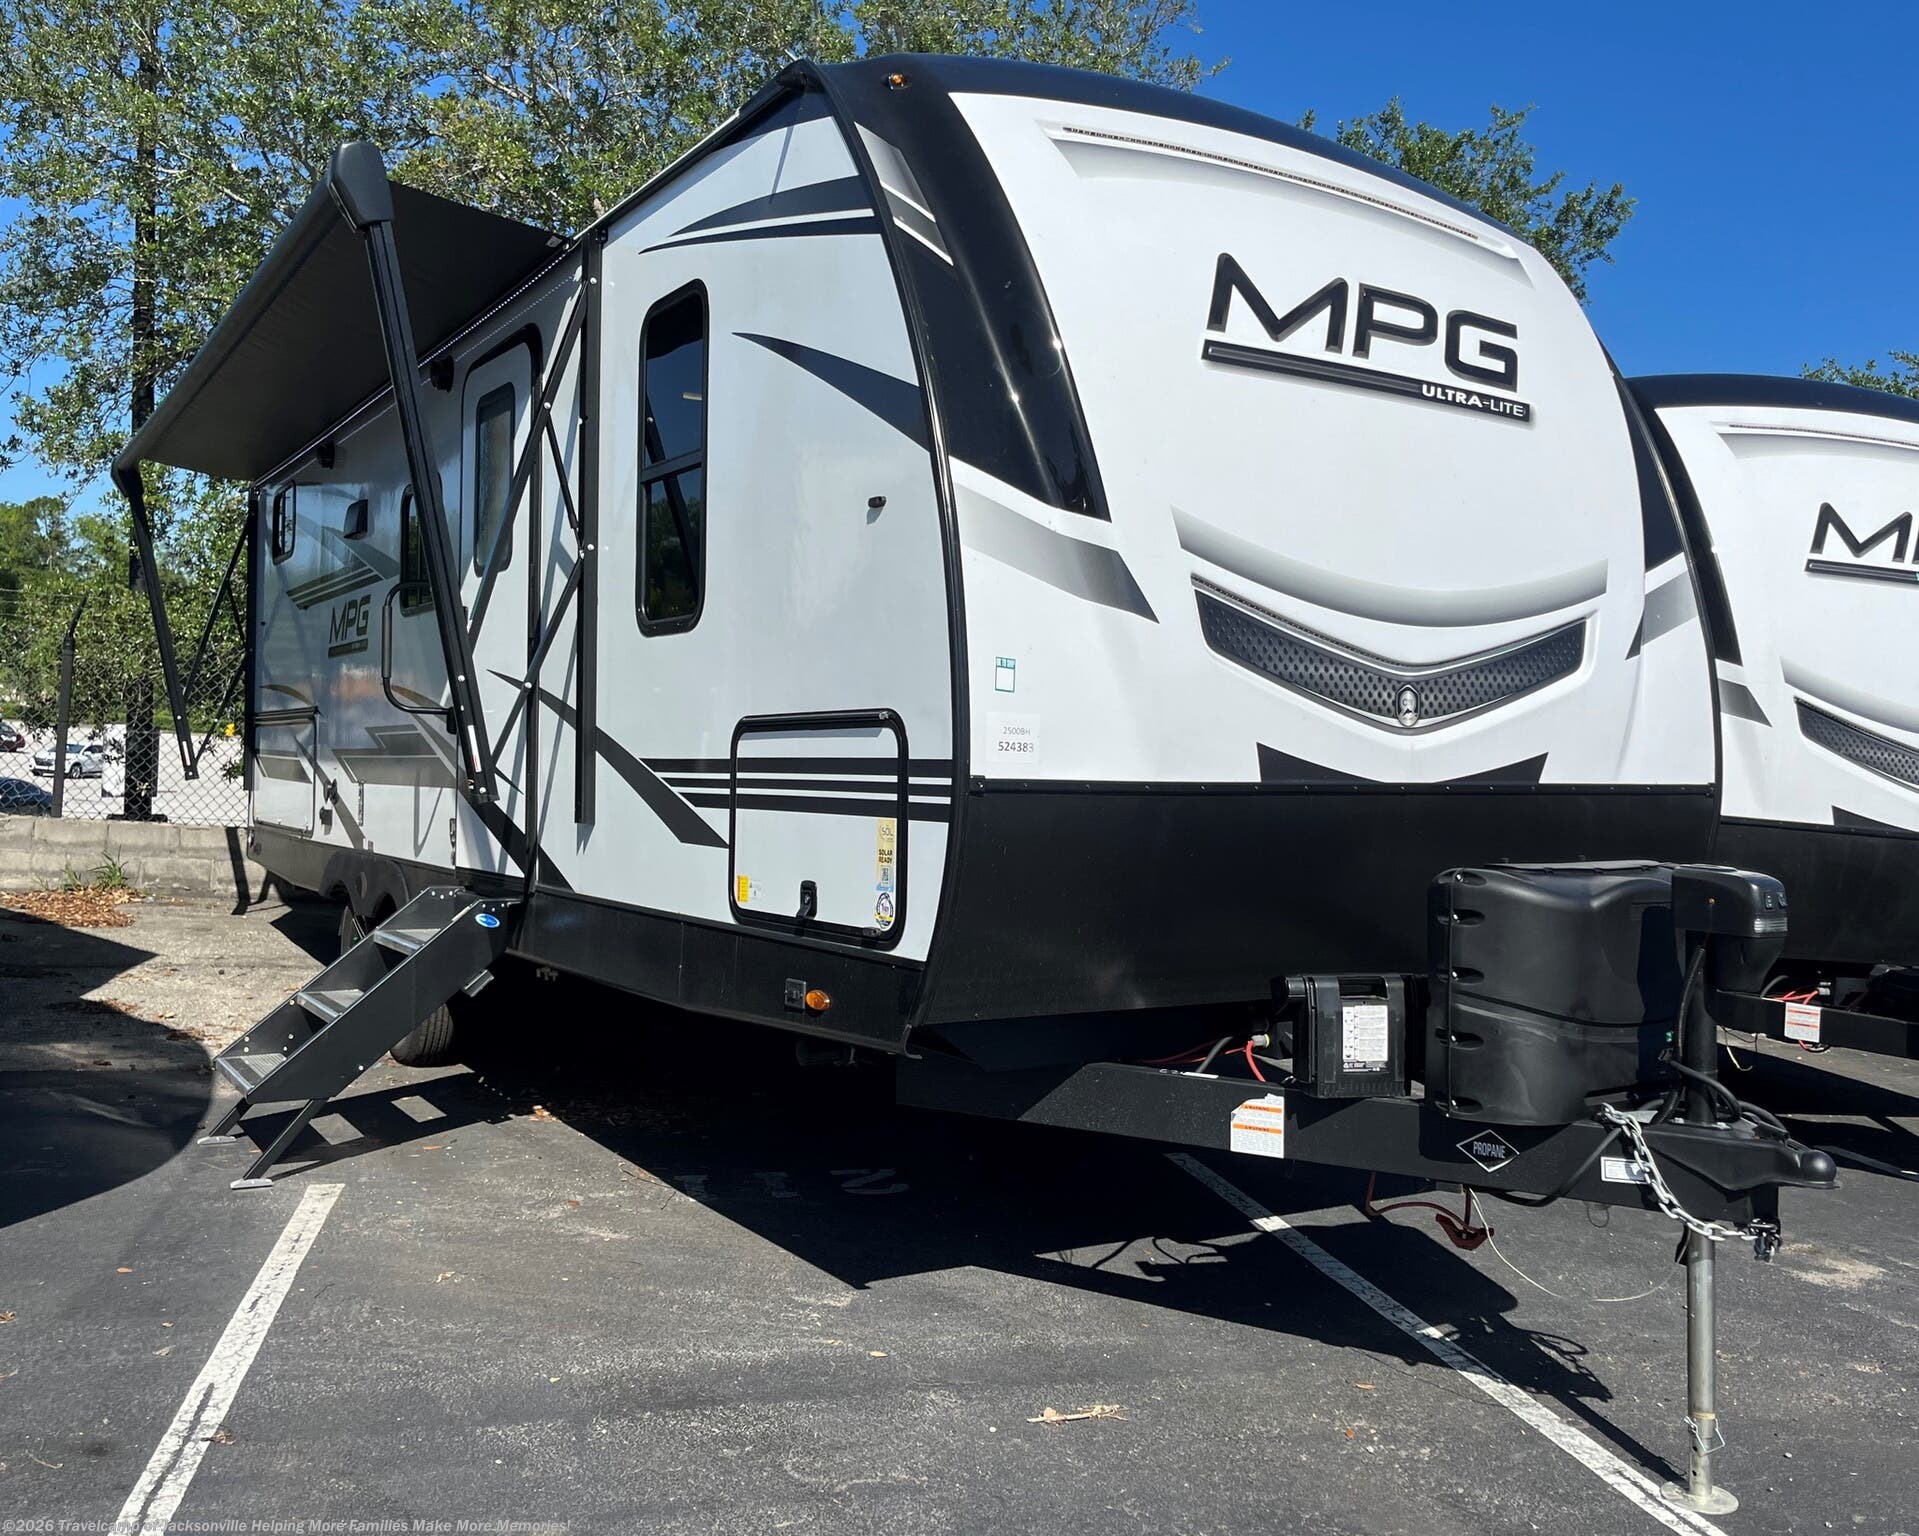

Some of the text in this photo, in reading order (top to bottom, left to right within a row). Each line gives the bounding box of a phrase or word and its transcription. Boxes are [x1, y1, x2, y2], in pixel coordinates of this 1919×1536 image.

[1206, 252, 1518, 393] MPG
[1422, 384, 1524, 417] ULTRA-LITE
[329, 594, 372, 645] MPG
[998, 741, 1034, 753] 524383
[1472, 1140, 1506, 1159] PROPANE
